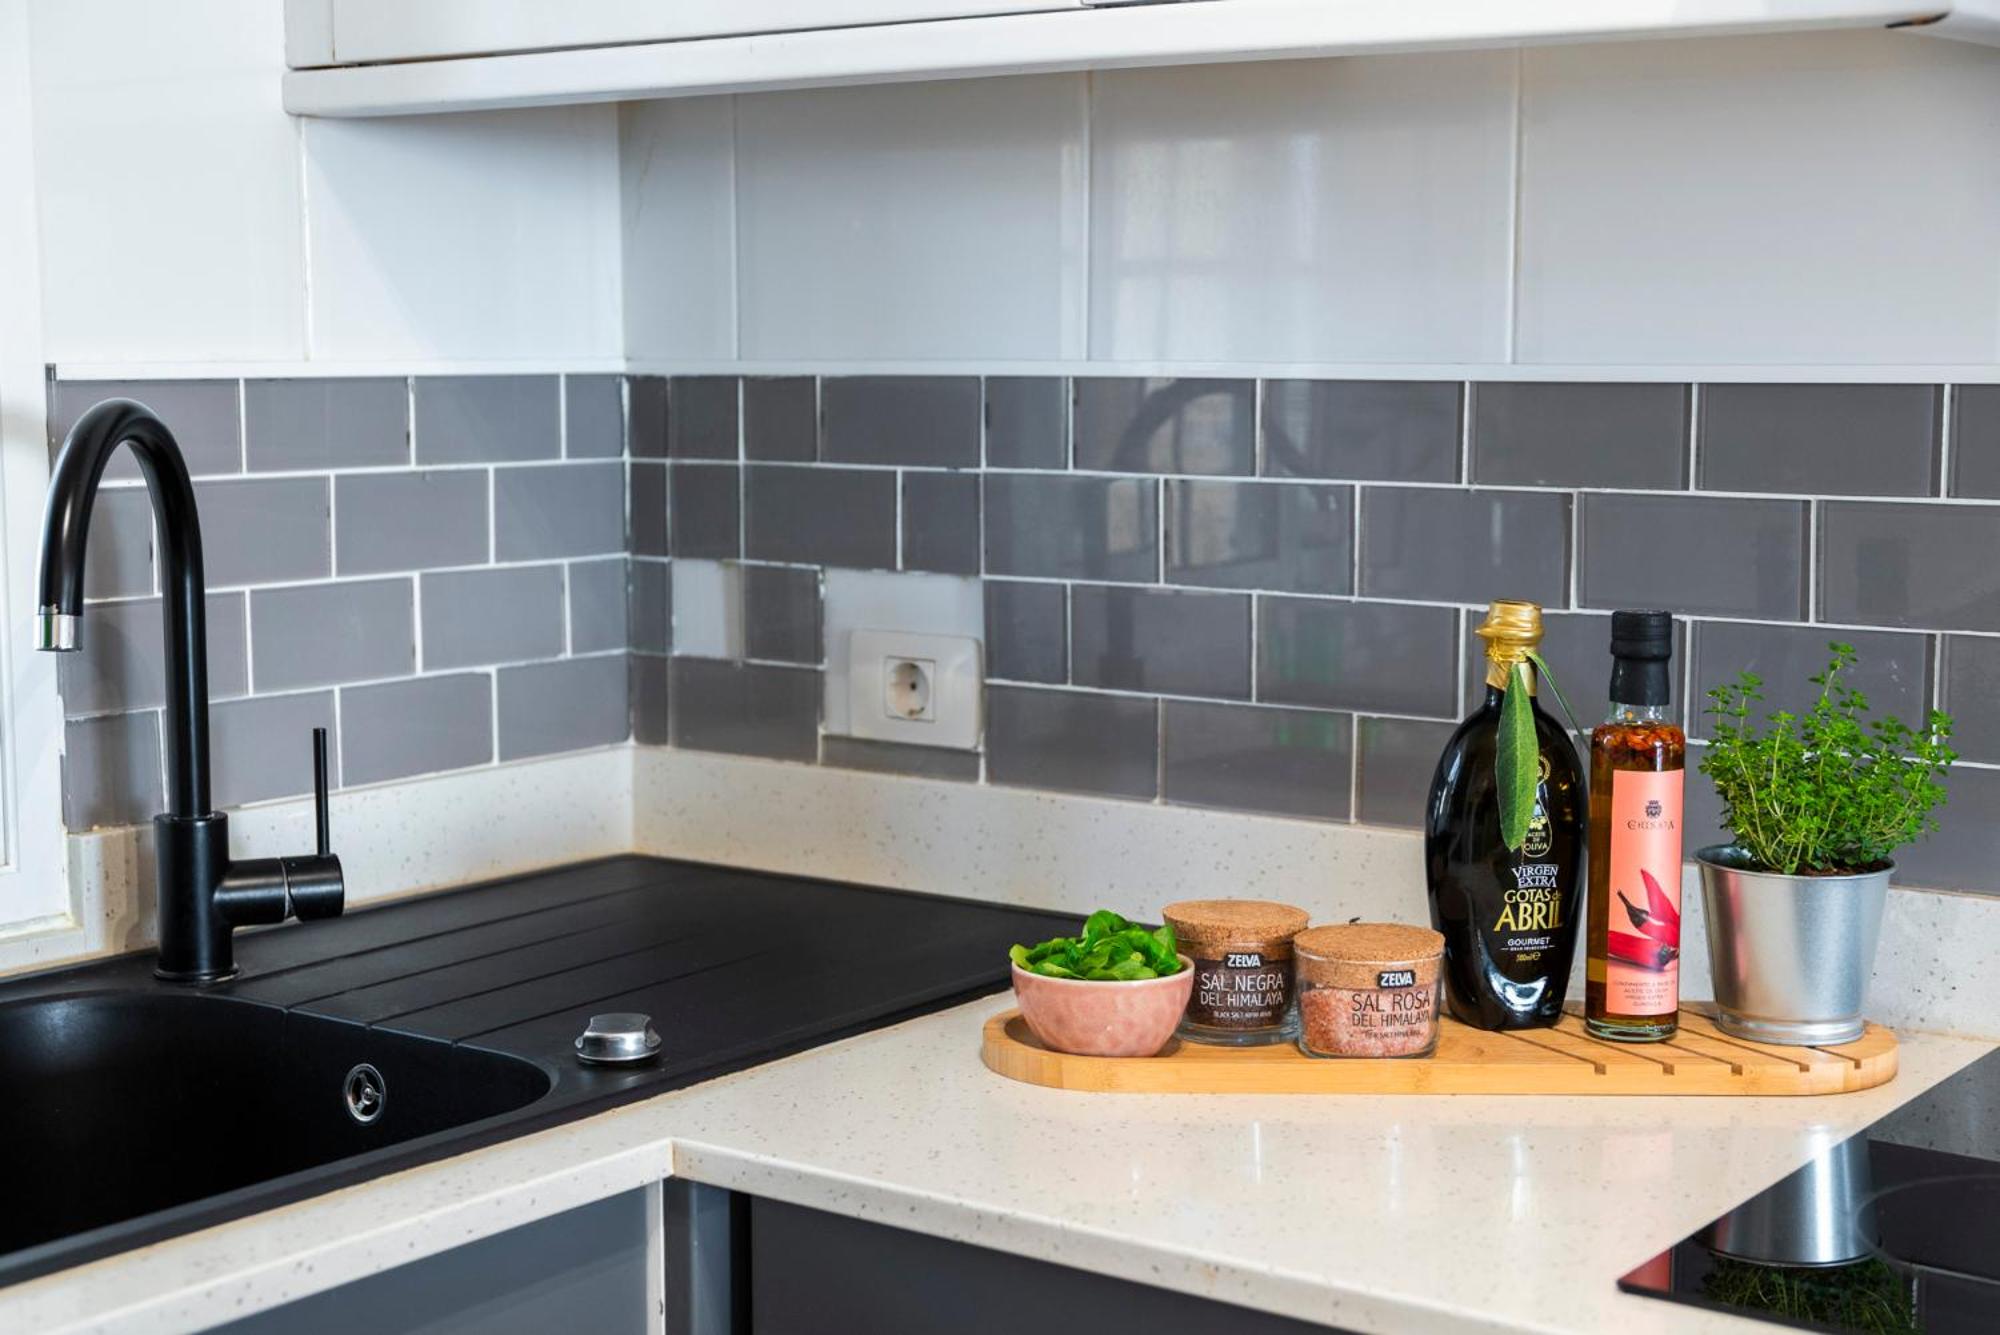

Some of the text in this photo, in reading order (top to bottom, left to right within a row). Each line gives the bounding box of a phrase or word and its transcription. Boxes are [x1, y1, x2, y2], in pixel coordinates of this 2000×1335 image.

[1523, 842, 1549, 851] OLIVA
[1512, 865, 1559, 878] VIRGEN
[1517, 876, 1557, 888] EXTRA
[1504, 888, 1551, 903] GOTAS
[1493, 900, 1563, 932] ABRIL
[1507, 937, 1551, 947] GOURMET
[1227, 954, 1261, 968] ZELVA
[1200, 973, 1284, 992] SAL NEGRA
[1380, 971, 1413, 987] ZELVA
[1200, 991, 1284, 1007] DEL HIMALAYA
[1351, 989, 1430, 1012] SAL ROSA
[1351, 1009, 1430, 1028] DEL HIMALAYA
